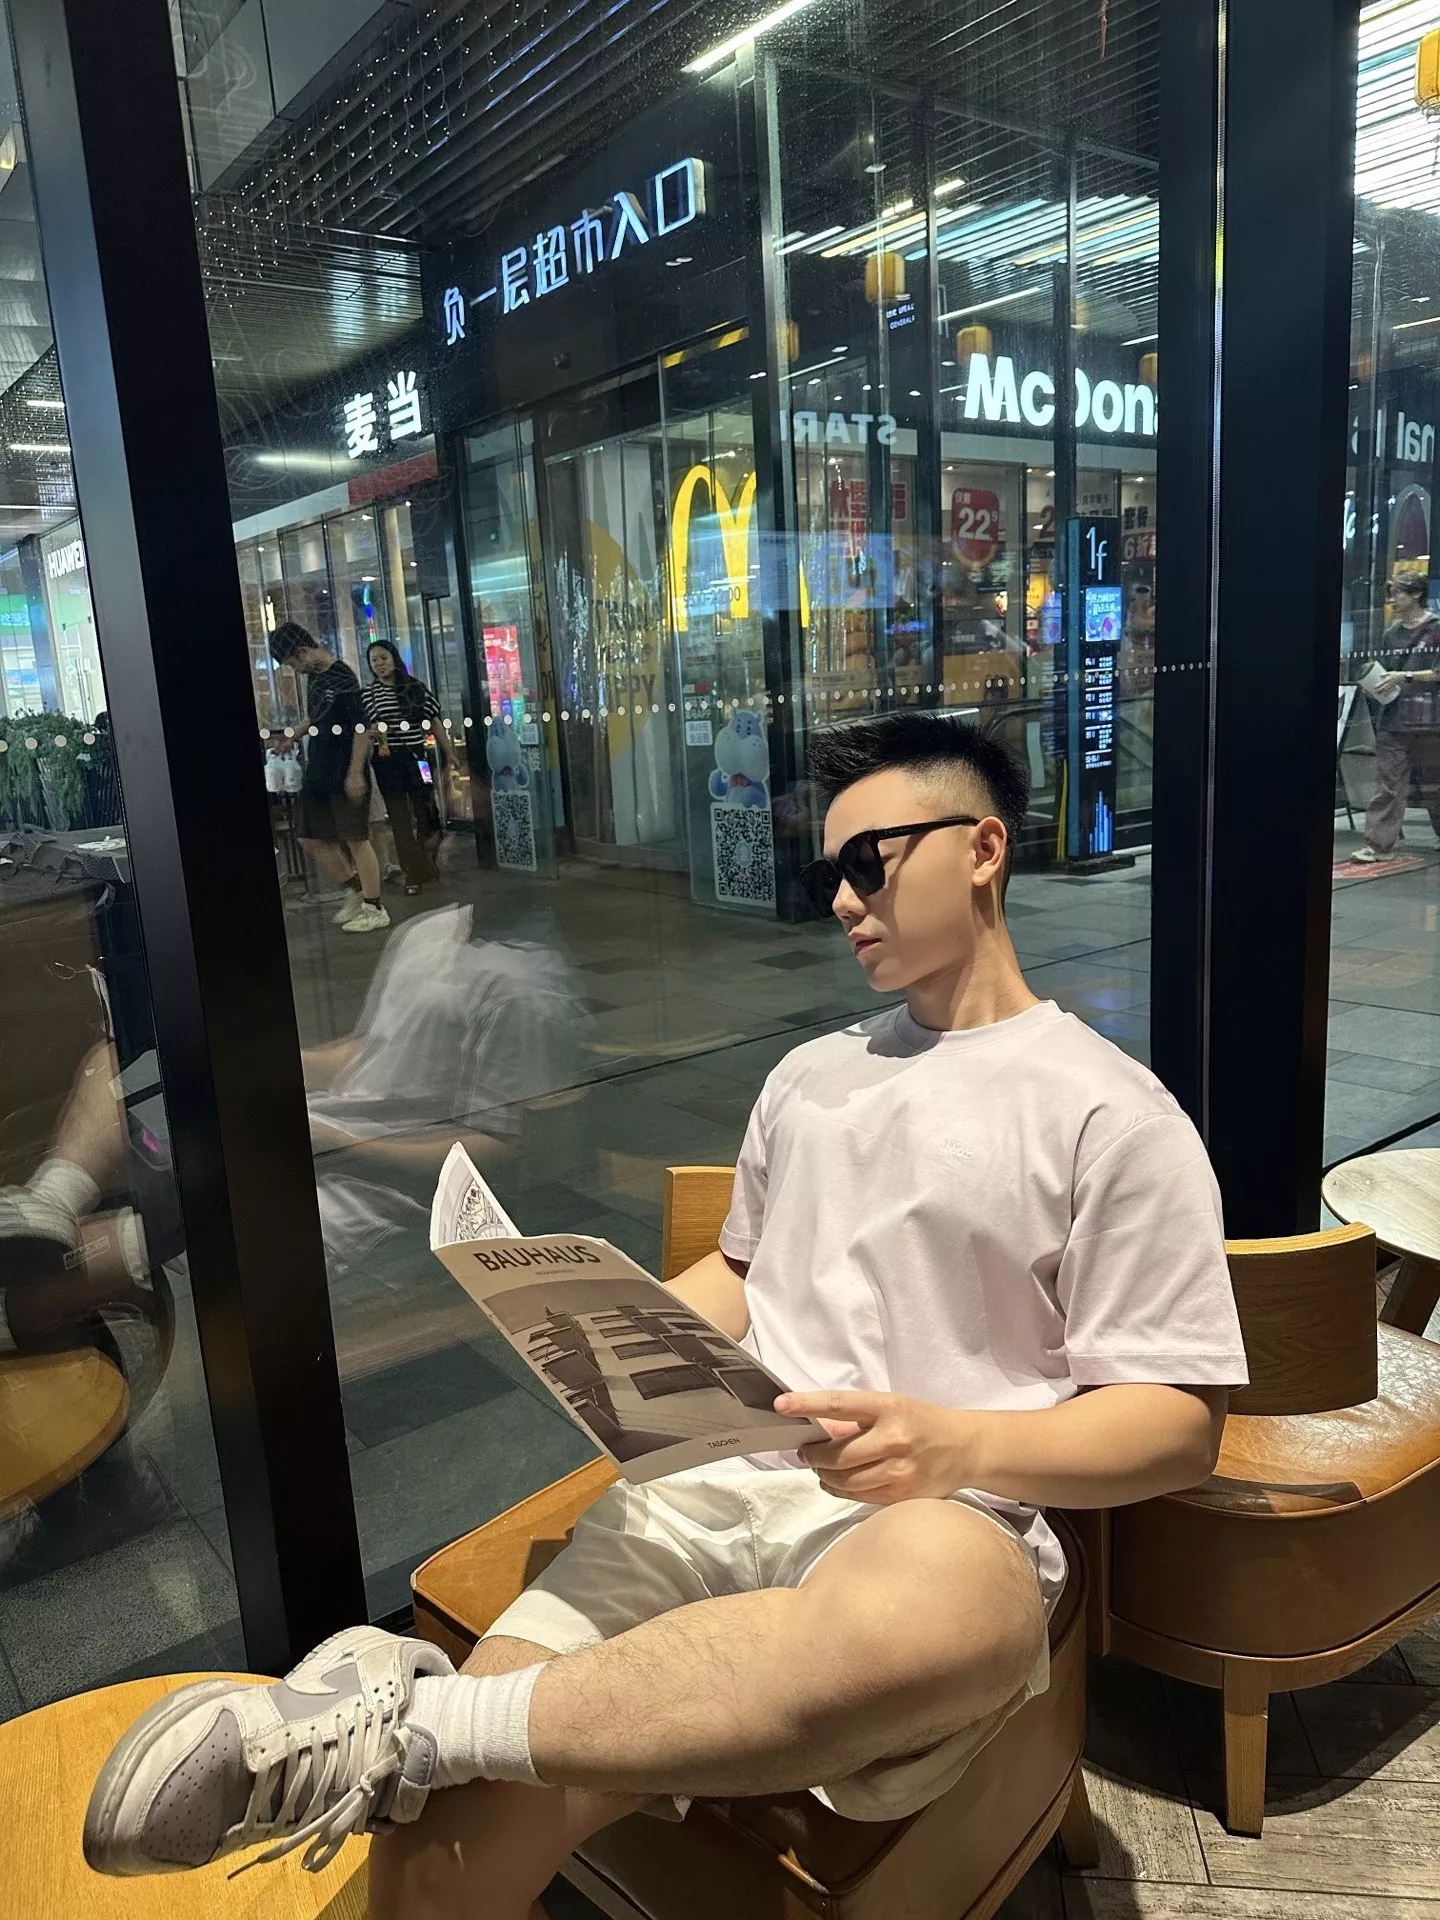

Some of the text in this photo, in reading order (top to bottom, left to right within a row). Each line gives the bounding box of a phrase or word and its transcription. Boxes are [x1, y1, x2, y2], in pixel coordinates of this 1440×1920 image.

[443, 157, 706, 346] 负一层超市入口
[343, 370, 422, 460] 麦当
[963, 352, 1158, 436] McDon
[472, 1245, 601, 1271] BAUHAUS
